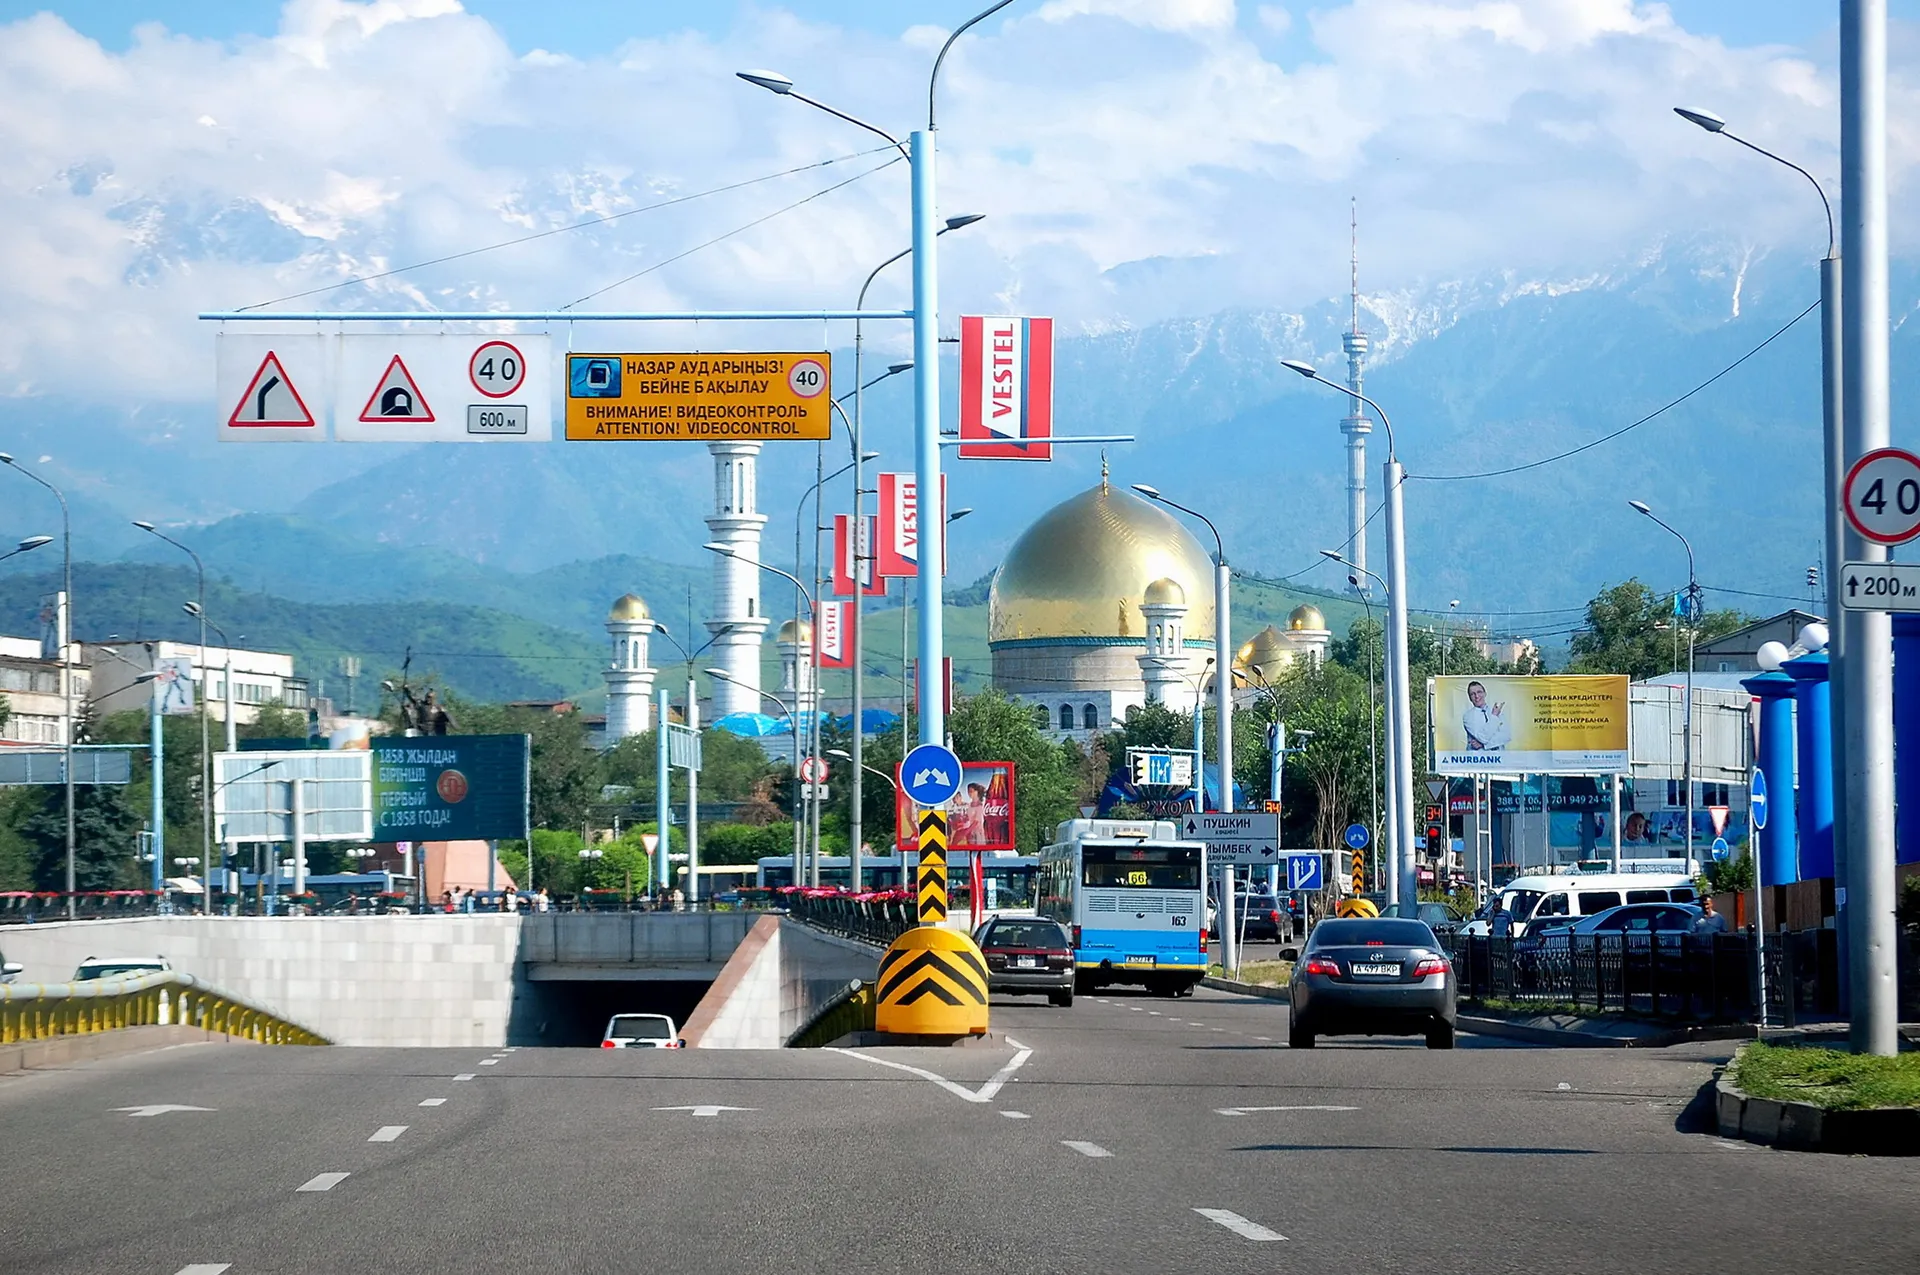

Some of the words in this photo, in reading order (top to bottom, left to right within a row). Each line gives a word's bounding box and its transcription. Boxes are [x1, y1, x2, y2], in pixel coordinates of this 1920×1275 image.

[478, 357, 516, 380] 40
[626, 361, 676, 375] НАЗАР
[992, 323, 1013, 418] VESTEL
[640, 378, 690, 393] БЕЙНЕ
[796, 370, 819, 386] 40
[479, 411, 504, 427] 600
[586, 405, 672, 419] ВНИМАНИЕ!
[676, 405, 808, 421] ВИДЕОКОНТРОЛЬ
[595, 421, 680, 434] ATTENTION!
[687, 421, 800, 435] VIDEOCONTROL
[1859, 478, 1920, 515] 40
[1863, 576, 1900, 596] 200
[826, 604, 837, 649] VESTEL
[378, 749, 404, 763] 1858
[406, 749, 457, 767] ЖЫЛДАН
[1451, 756, 1501, 764] NURBANK
[380, 787, 427, 806] ПЕРВЫЙ
[1551, 795, 1567, 805] 701
[1569, 795, 1586, 805] 949
[1588, 795, 1599, 805] 24
[1266, 802, 1280, 813] 34
[1427, 806, 1441, 820] 34
[391, 811, 416, 827] 1858
[418, 809, 451, 828] ГОДА!
[1203, 818, 1251, 828] ПУШКИН
[1132, 873, 1145, 884] 66
[1171, 915, 1187, 927] 163
